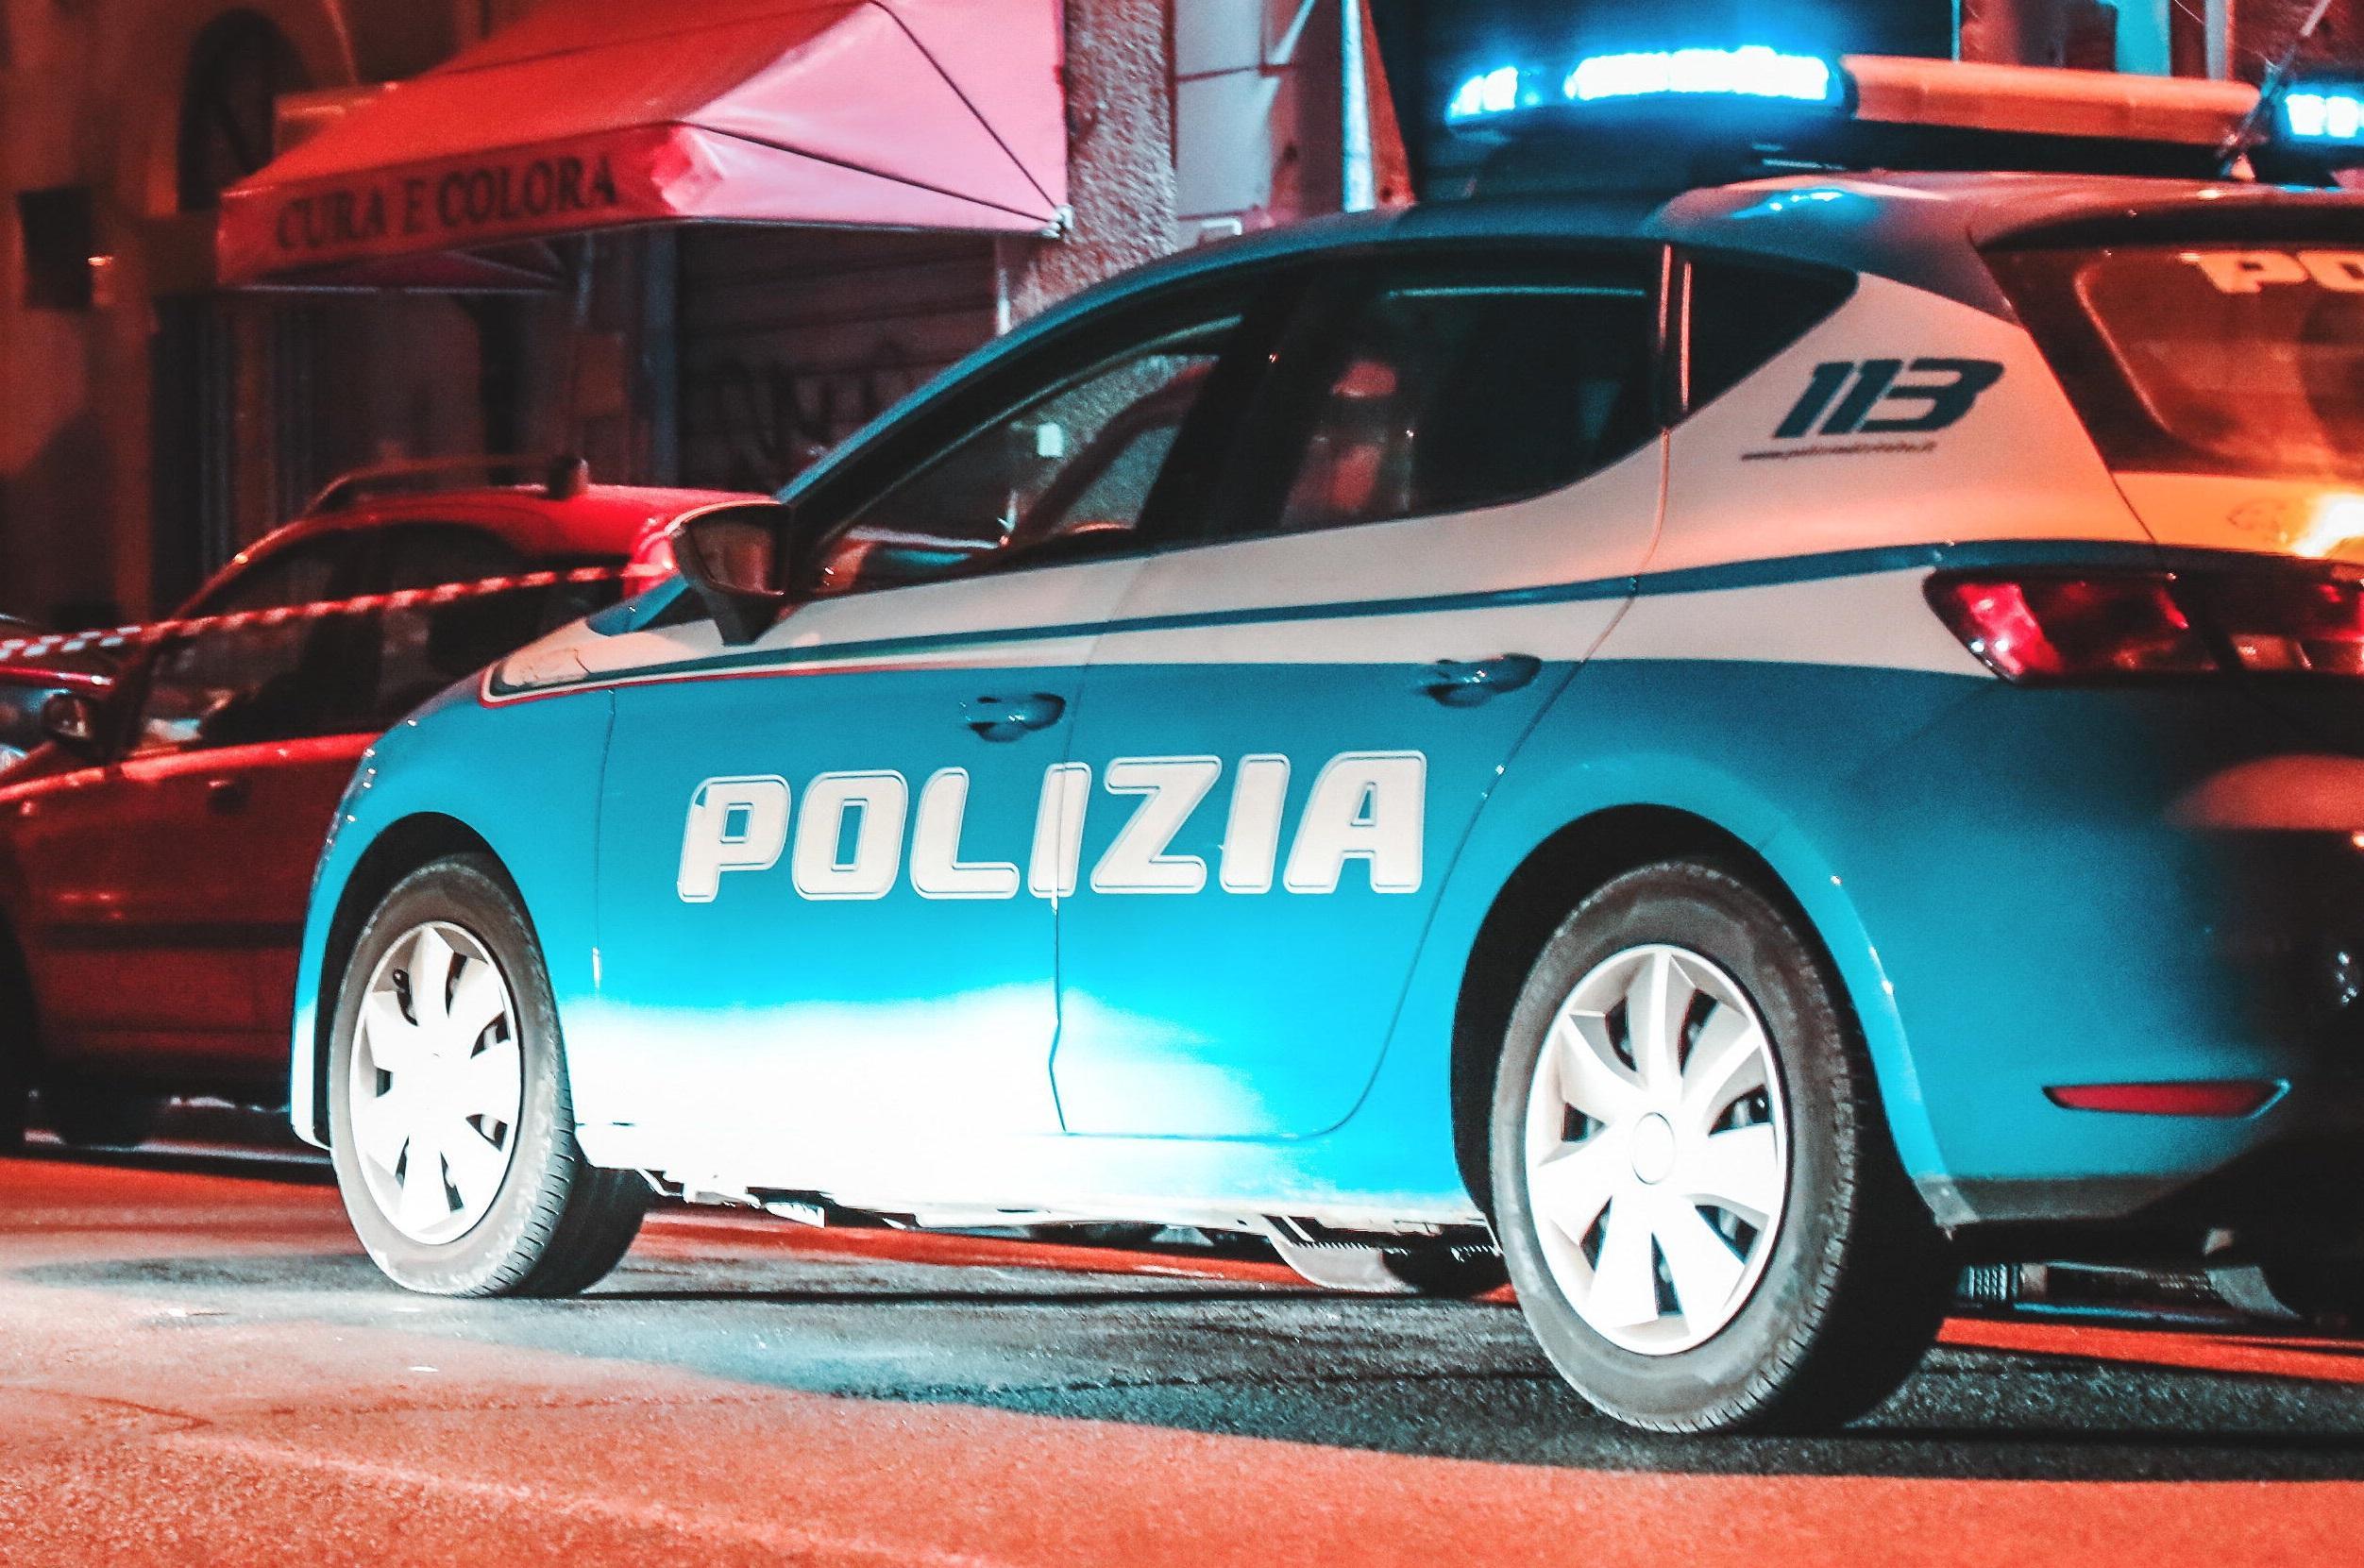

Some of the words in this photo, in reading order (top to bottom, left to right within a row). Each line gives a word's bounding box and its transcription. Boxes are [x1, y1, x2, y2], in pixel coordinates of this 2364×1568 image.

[278, 189, 387, 249] CURA
[403, 178, 430, 234] E
[438, 155, 617, 228] COLORA
[1772, 357, 2006, 439] 113
[677, 750, 1427, 903] POLIZIA
